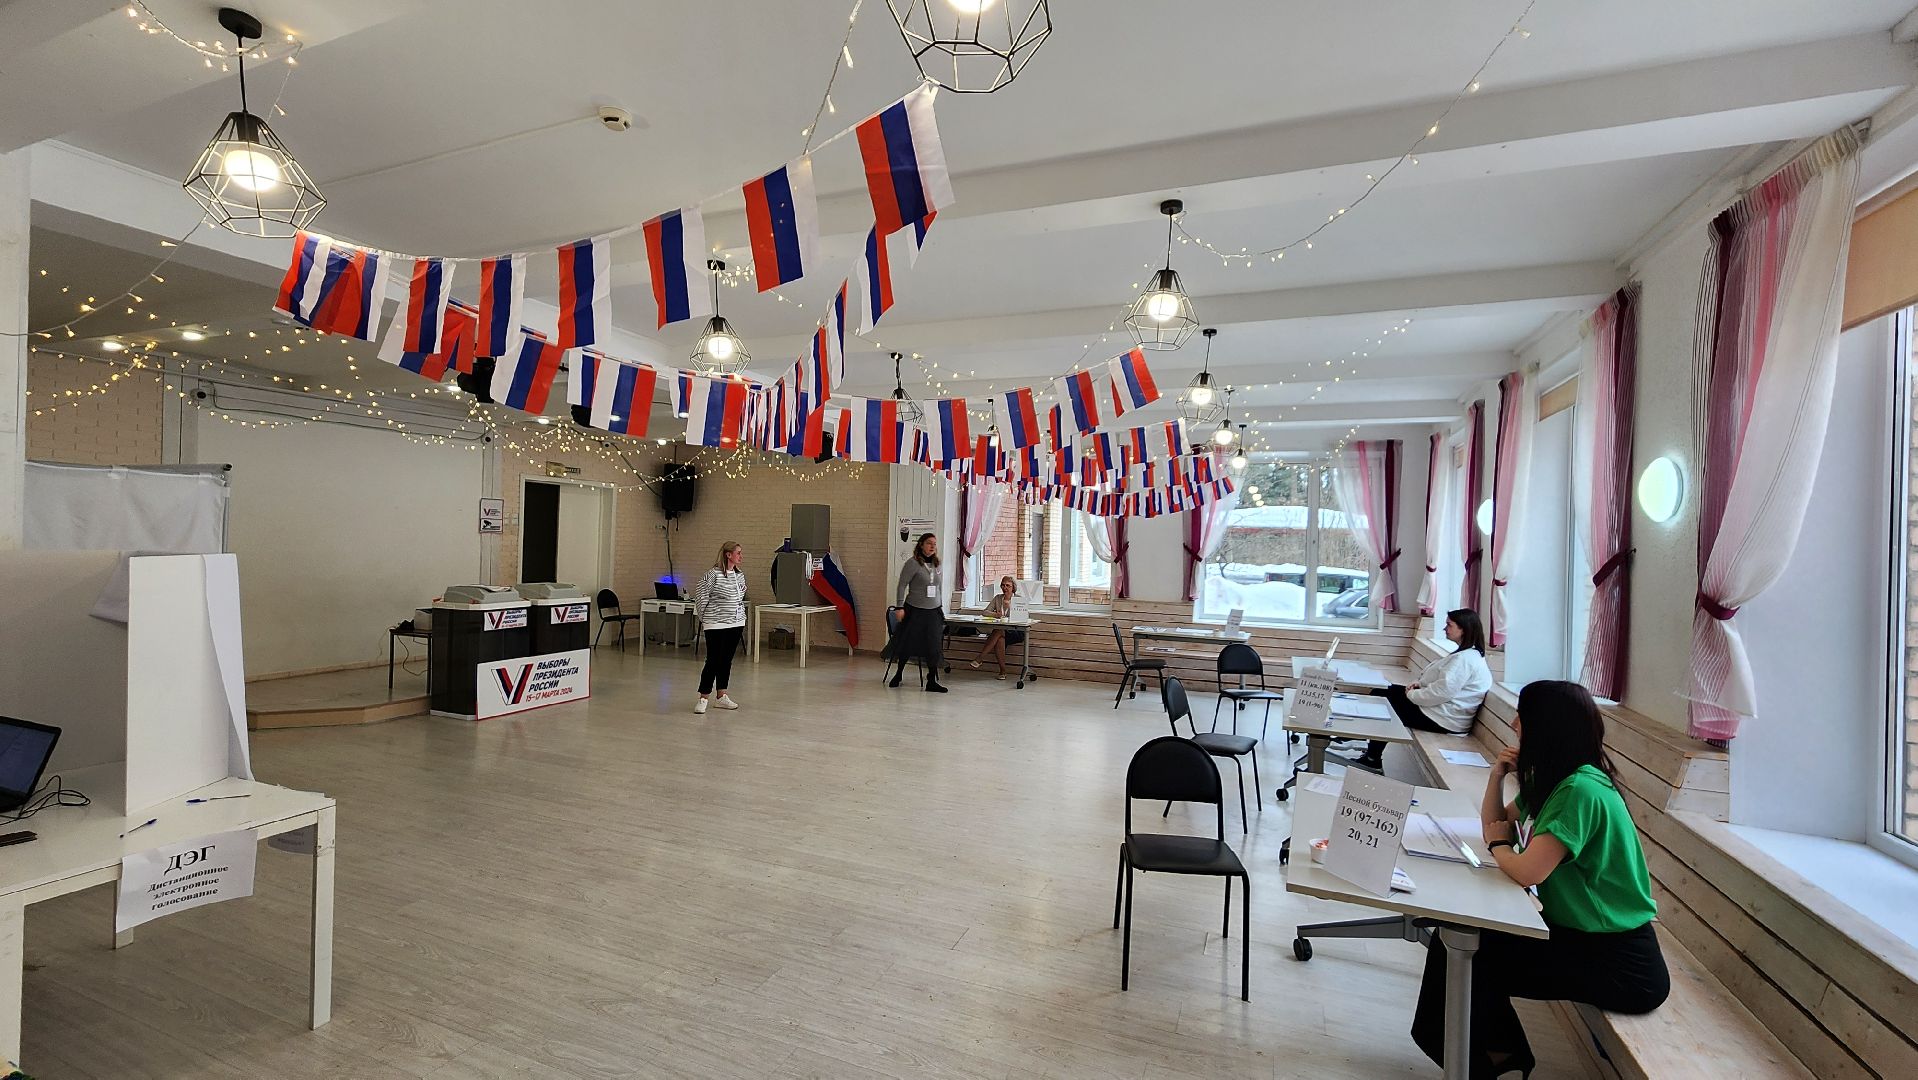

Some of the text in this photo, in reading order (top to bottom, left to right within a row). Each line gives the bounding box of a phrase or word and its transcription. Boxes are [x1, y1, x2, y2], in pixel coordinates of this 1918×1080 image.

[533, 666, 579, 681] ПРЕЗИДЕНТА
[537, 658, 571, 670] ВЫБОРЫ
[528, 680, 560, 692] РОССИИ
[541, 689, 560, 699] МАРТА
[560, 687, 573, 695] 2024
[1343, 791, 1404, 820] Лесной бульвар
[1340, 806, 1399, 837] 19 (97-162)
[1347, 828, 1379, 848] 20, 21
[164, 845, 216, 876] ДЭГ
[147, 865, 229, 893] Дистанционное
[153, 877, 220, 900] электронное
[152, 888, 219, 911] голосование
